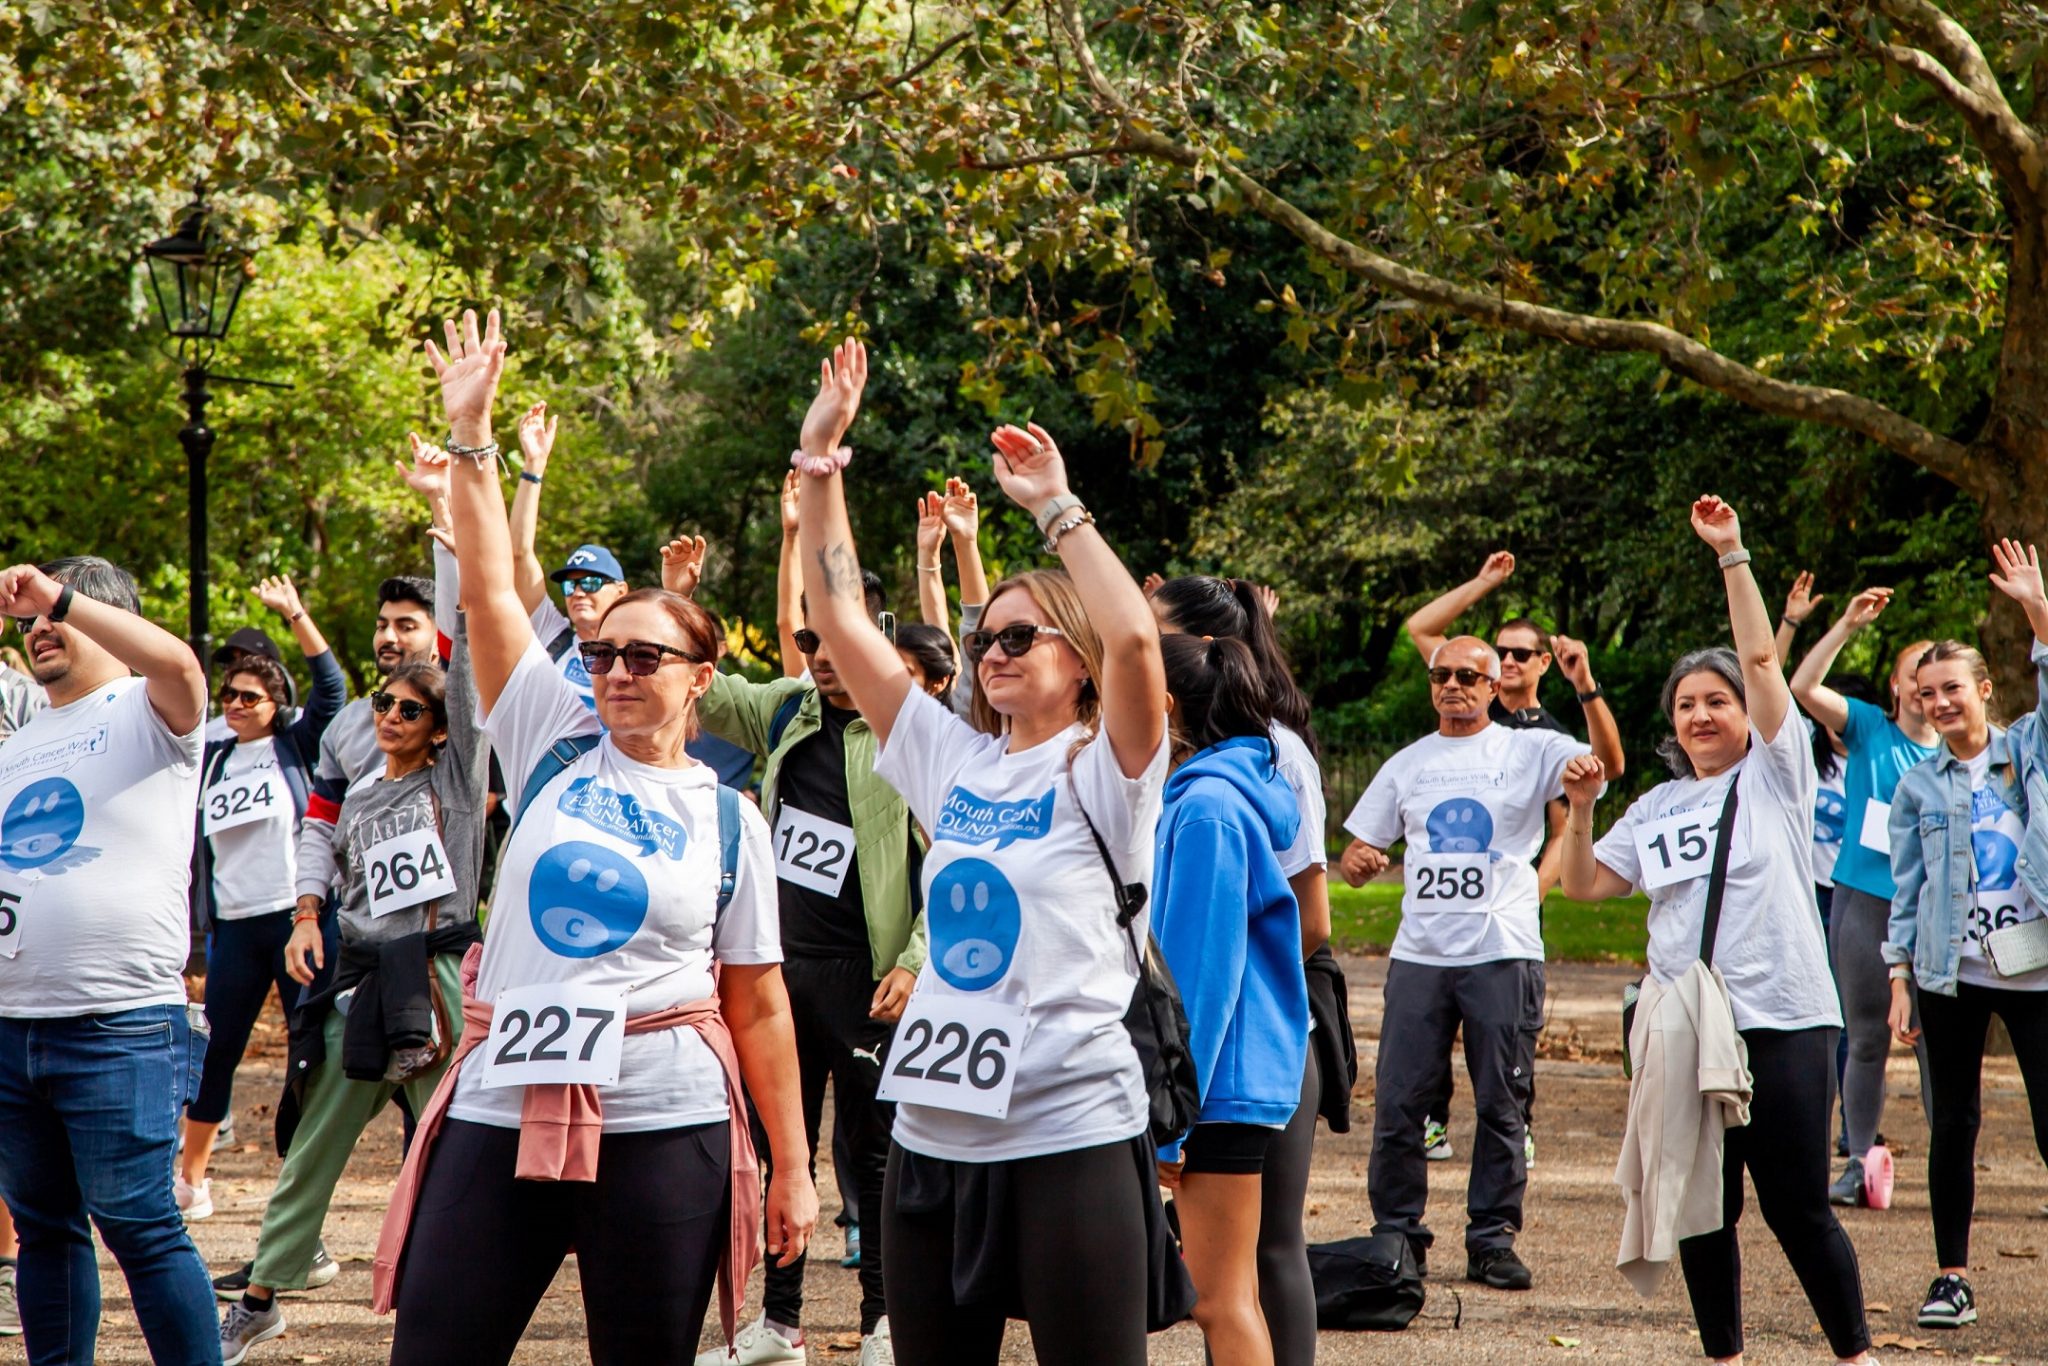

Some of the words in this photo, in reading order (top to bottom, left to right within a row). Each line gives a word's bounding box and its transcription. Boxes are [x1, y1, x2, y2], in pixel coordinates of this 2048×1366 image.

[210, 781, 274, 821] 324
[577, 780, 624, 814] Mouth
[779, 824, 846, 880] 122
[370, 843, 445, 902] 264
[1416, 866, 1485, 900] 258
[565, 917, 585, 938] C
[966, 947, 980, 970] C
[493, 1005, 616, 1066] 227
[892, 1018, 1011, 1091] 226
